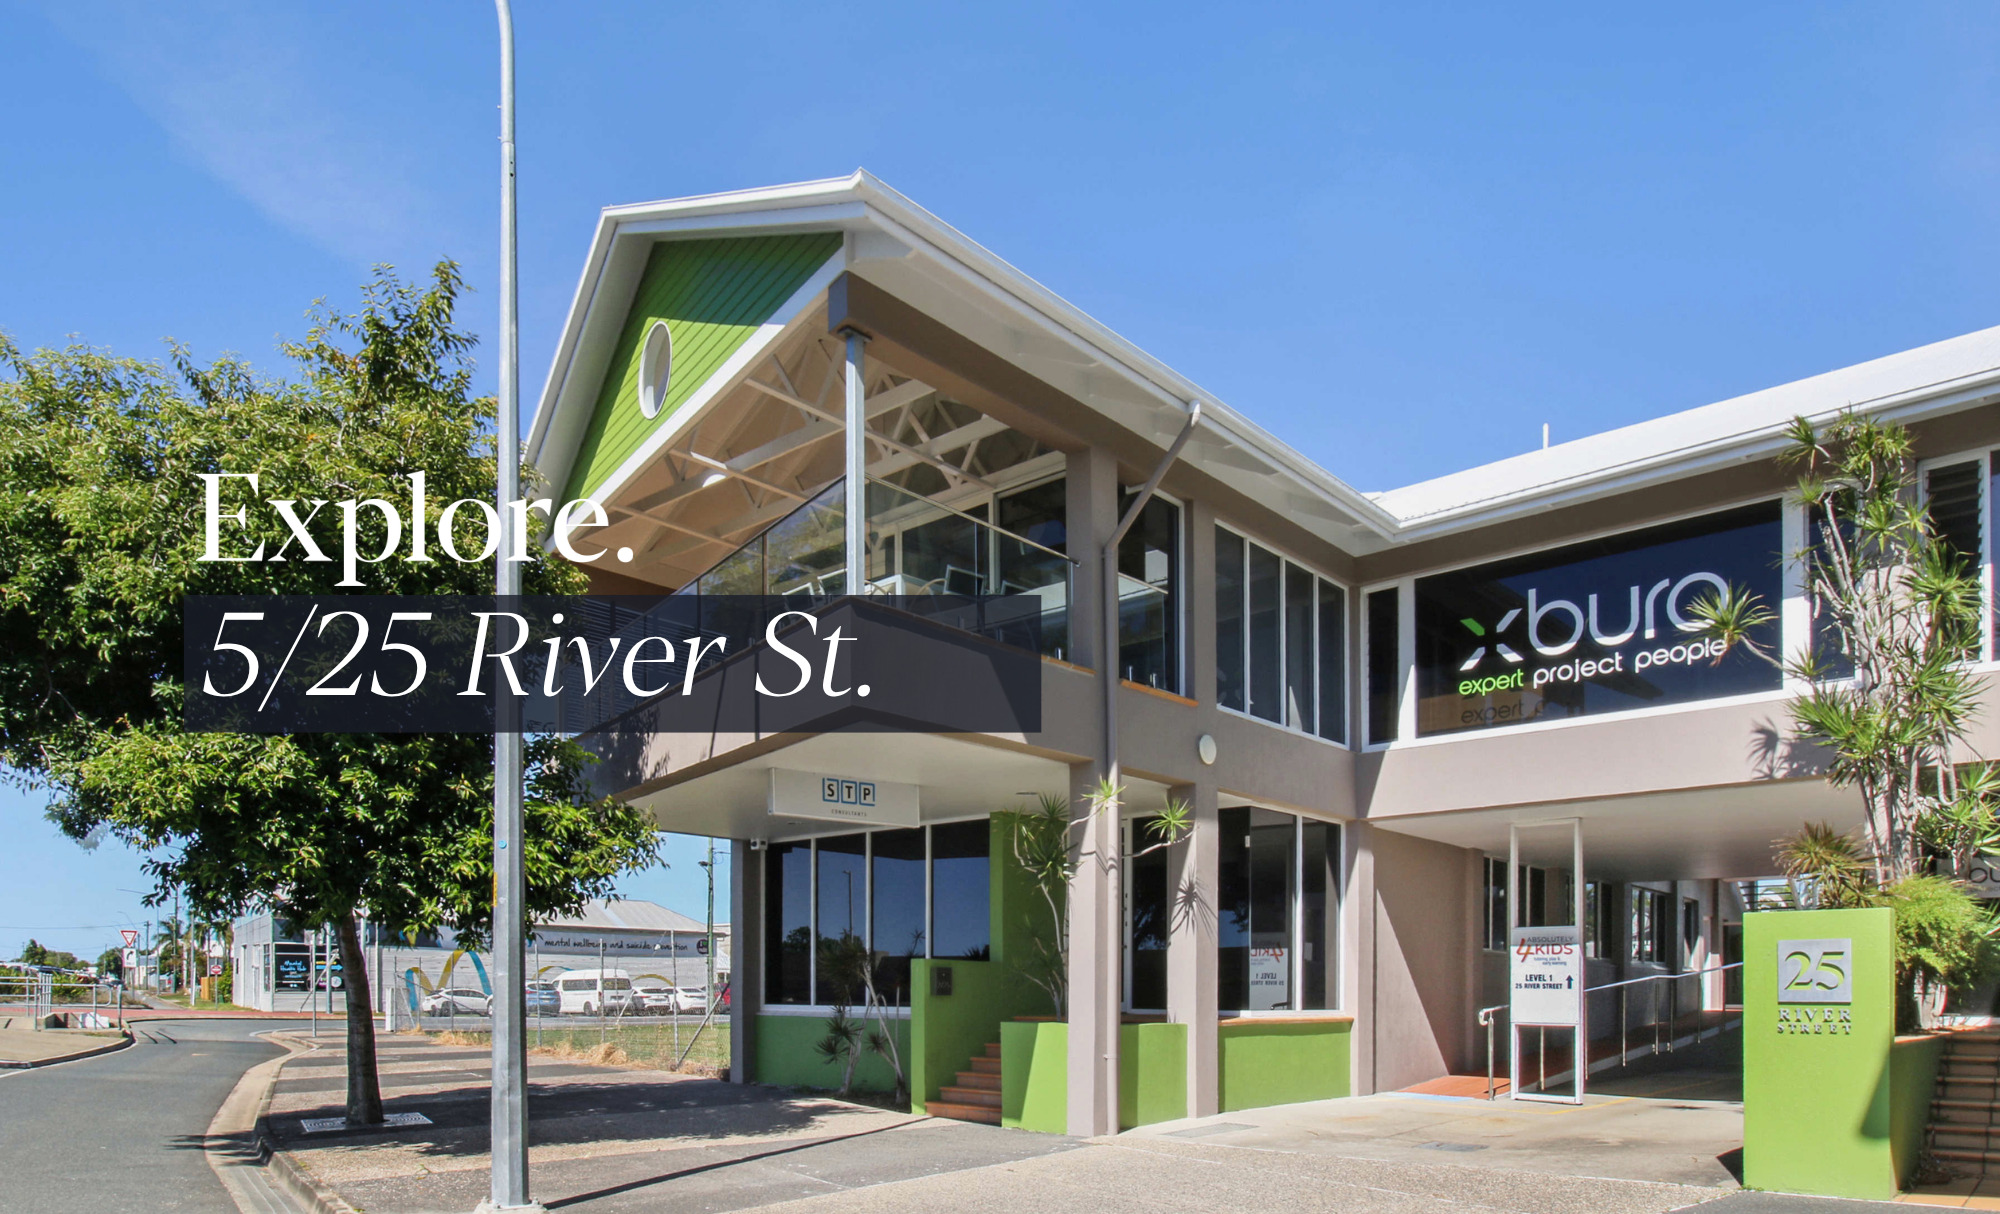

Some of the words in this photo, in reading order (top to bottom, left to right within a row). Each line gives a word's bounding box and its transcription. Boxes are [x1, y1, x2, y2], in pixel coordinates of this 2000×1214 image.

[1458, 669, 1525, 697] expert
[1533, 651, 1623, 690] project
[1634, 637, 1727, 674] people
[827, 783, 871, 801] STP
[831, 809, 868, 817] CONSULTANTS
[544, 937, 570, 947] mental
[1784, 950, 1845, 991] 25
[1525, 974, 1547, 982] LEVEL
[1549, 974, 1553, 982] 1
[1778, 1008, 1852, 1023] RIVER
[1777, 1023, 1852, 1035] STREET
